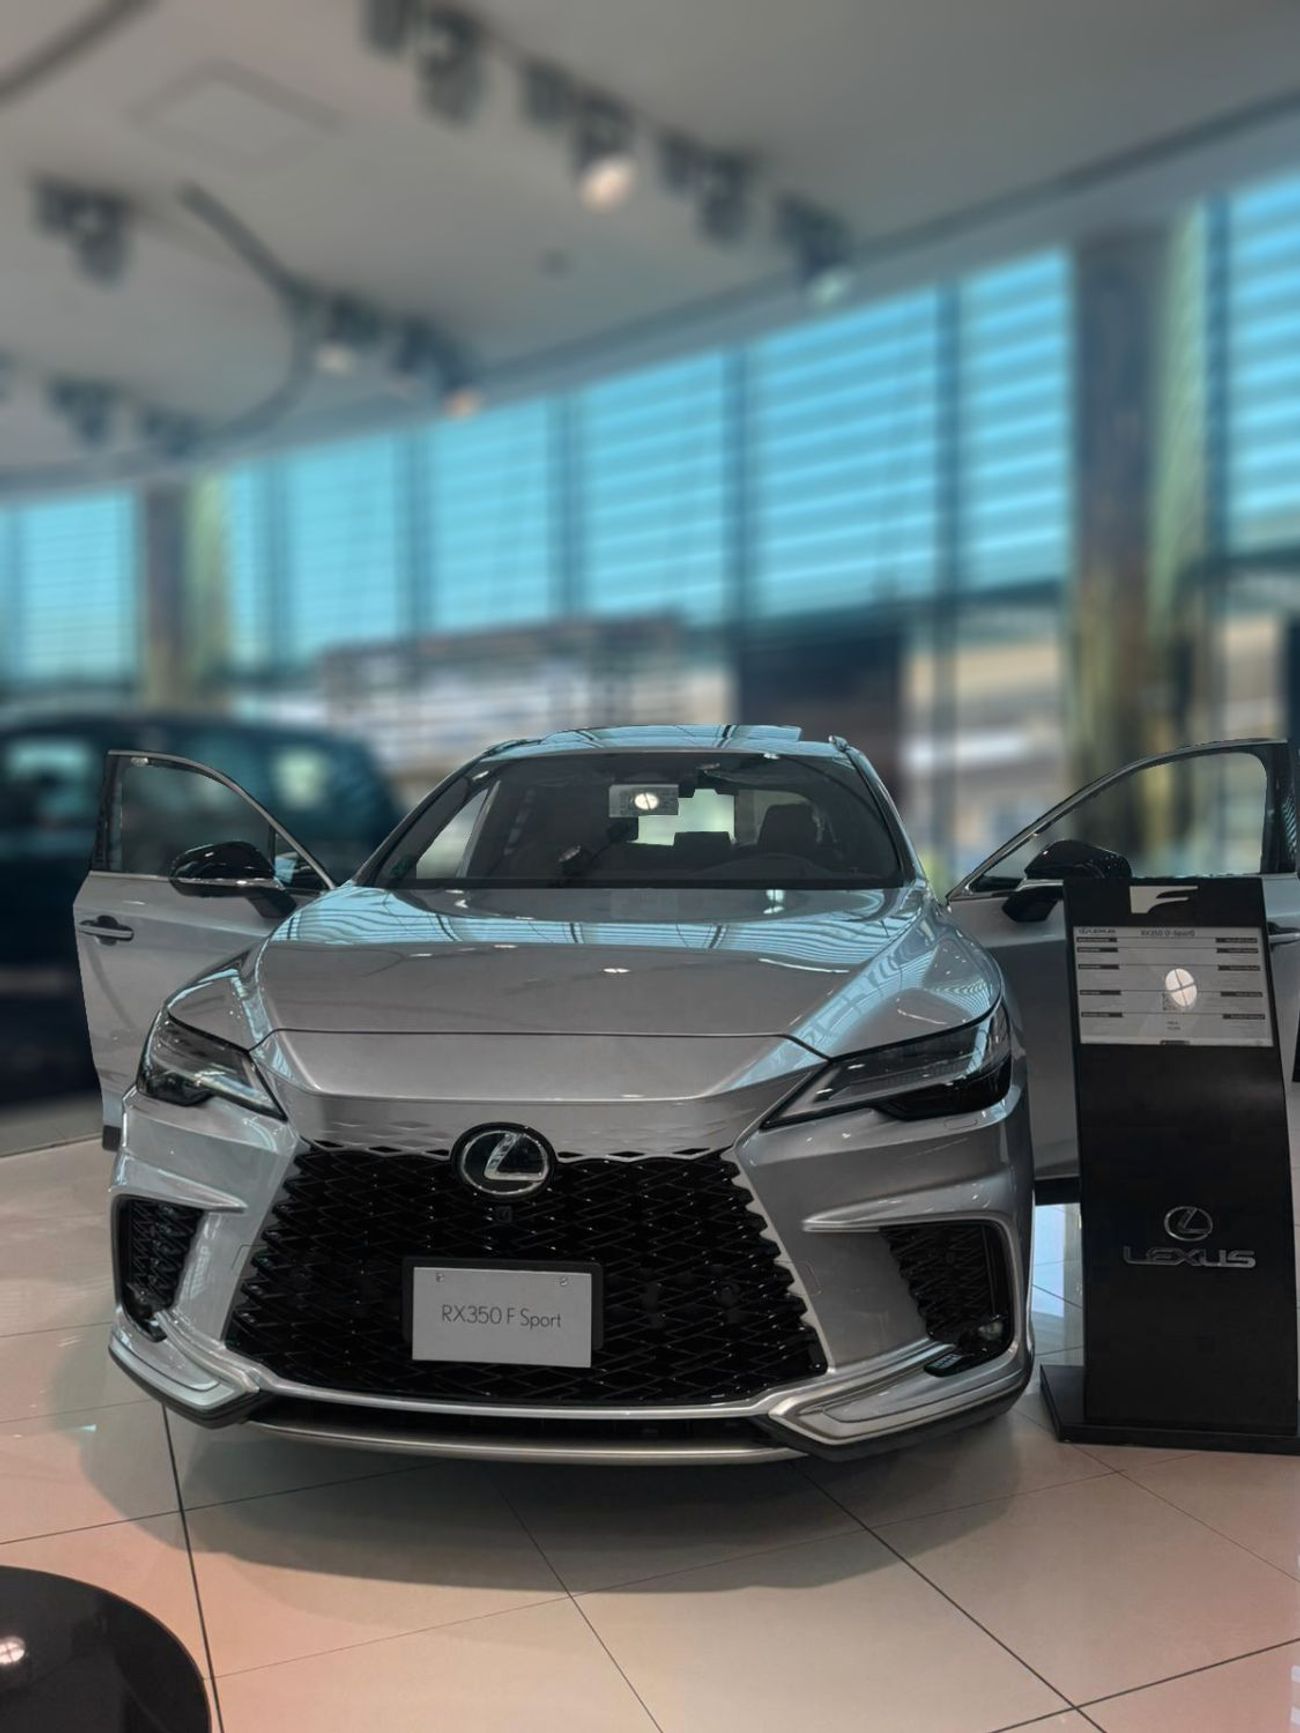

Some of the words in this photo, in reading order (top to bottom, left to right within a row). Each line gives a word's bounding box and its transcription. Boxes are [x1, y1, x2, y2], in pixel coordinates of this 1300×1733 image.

[1123, 1246, 1256, 1268] LEXUS
[441, 1304, 503, 1325] RX350
[506, 1307, 516, 1325] F
[519, 1308, 561, 1330] Sport
